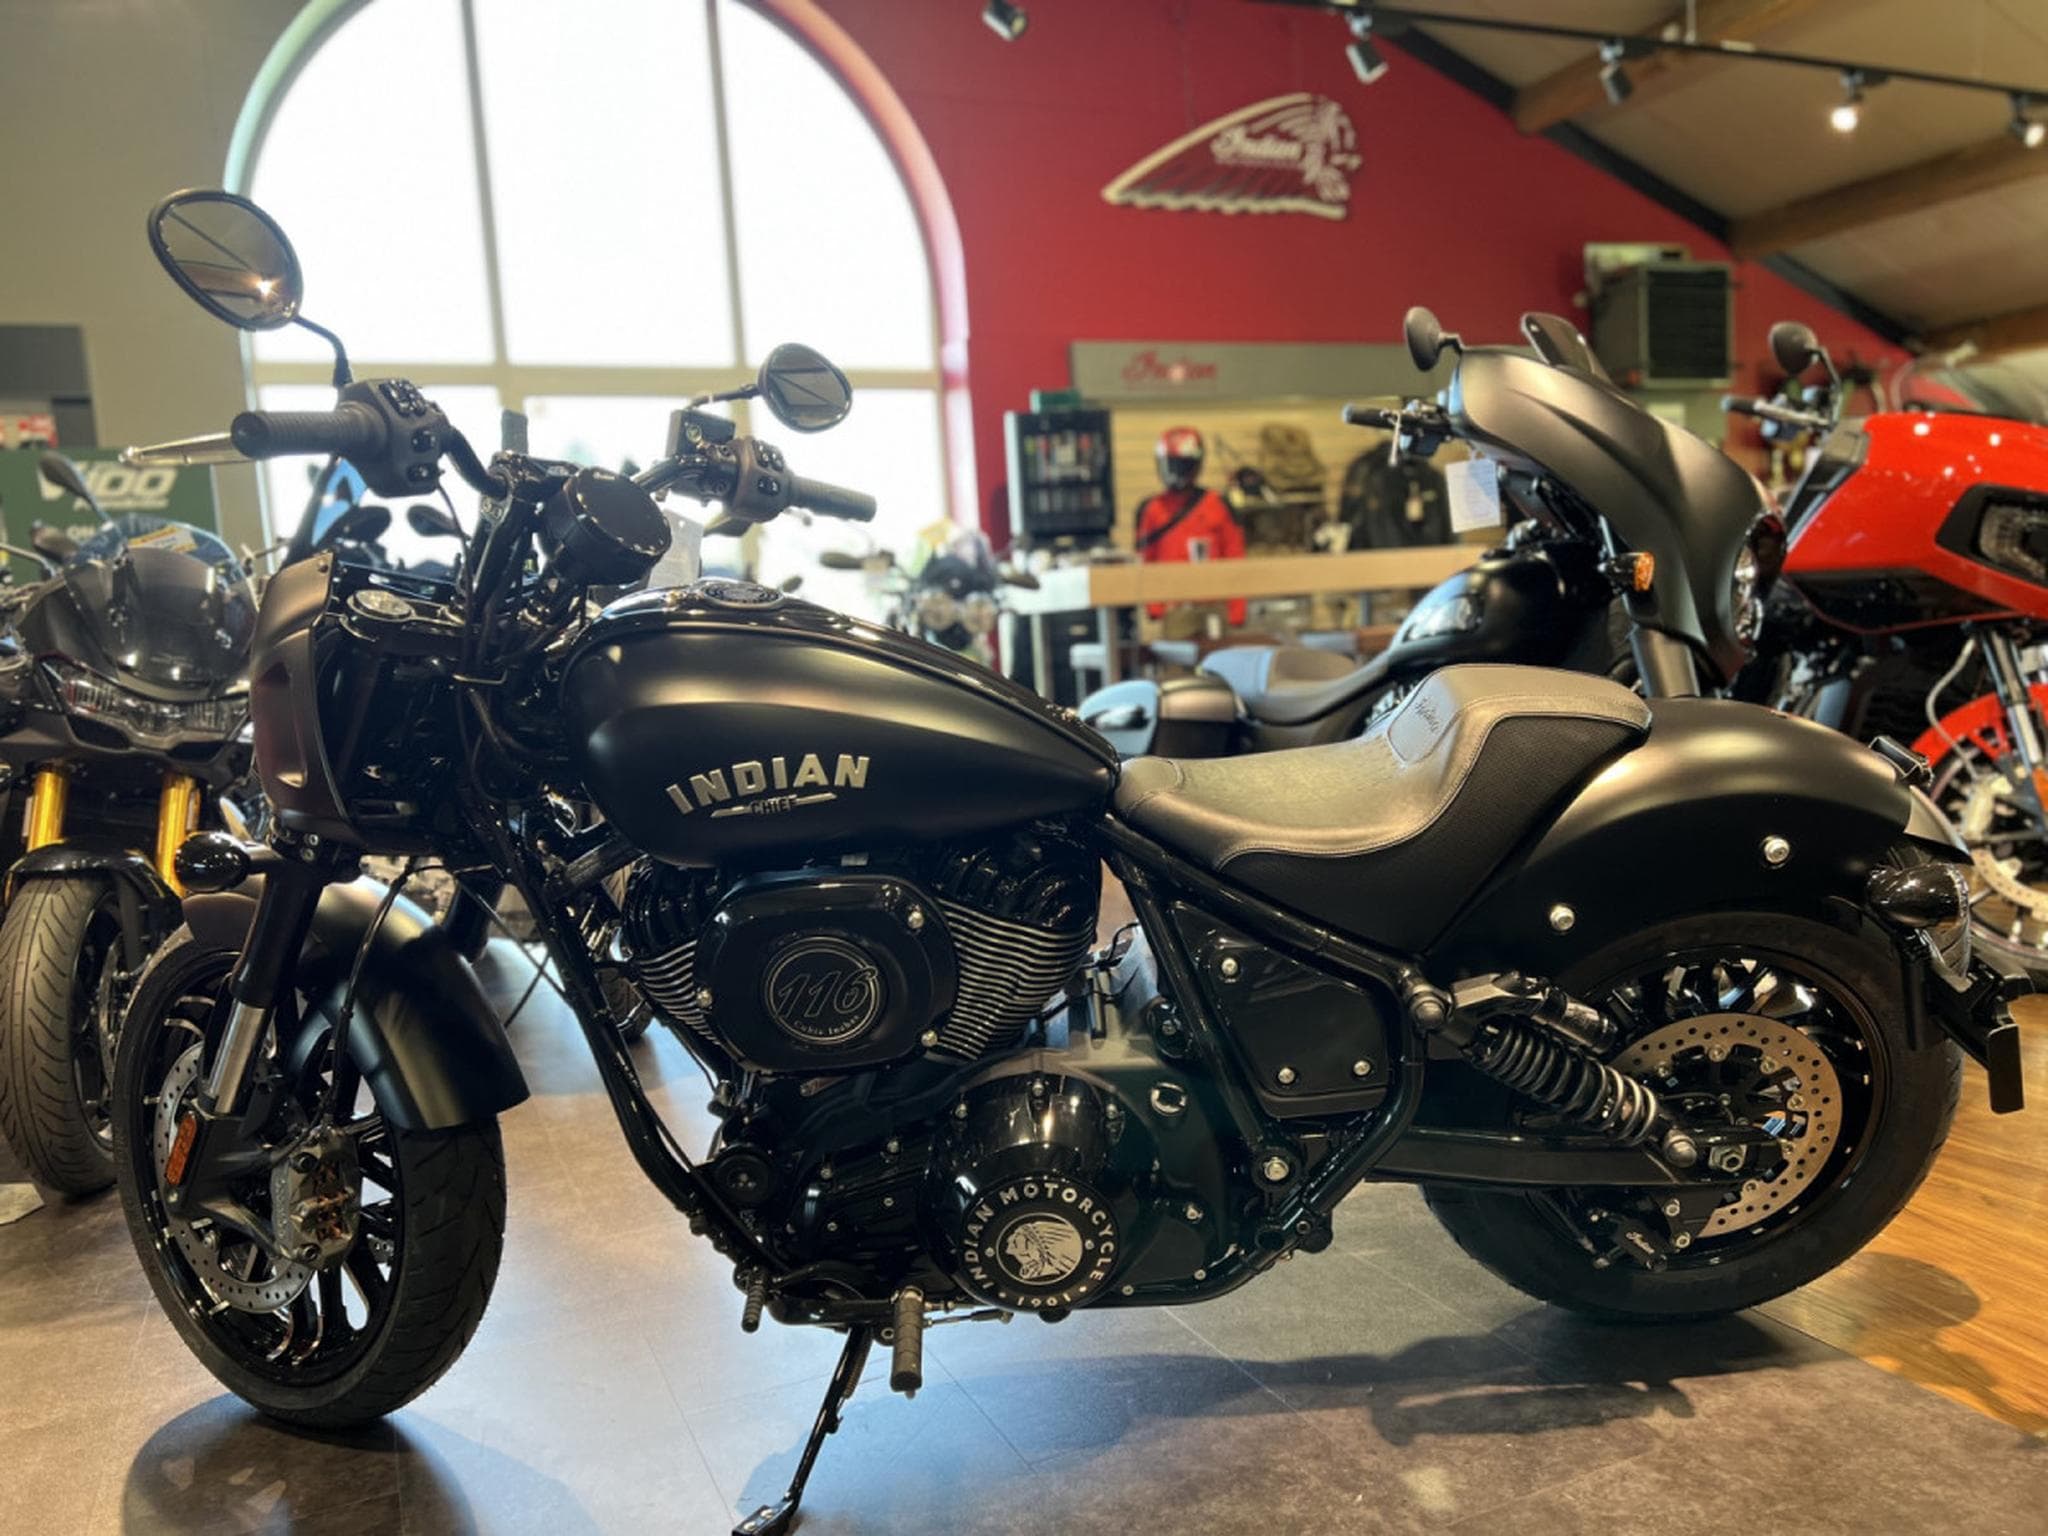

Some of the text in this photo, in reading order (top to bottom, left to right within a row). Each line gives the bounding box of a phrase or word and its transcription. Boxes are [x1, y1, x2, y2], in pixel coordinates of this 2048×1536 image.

[666, 753, 870, 815] INDIAN
[750, 794, 797, 815] CHIEF
[778, 965, 878, 1019] 116
[963, 1181, 1116, 1290] INDIAN MOTORCYCLE
